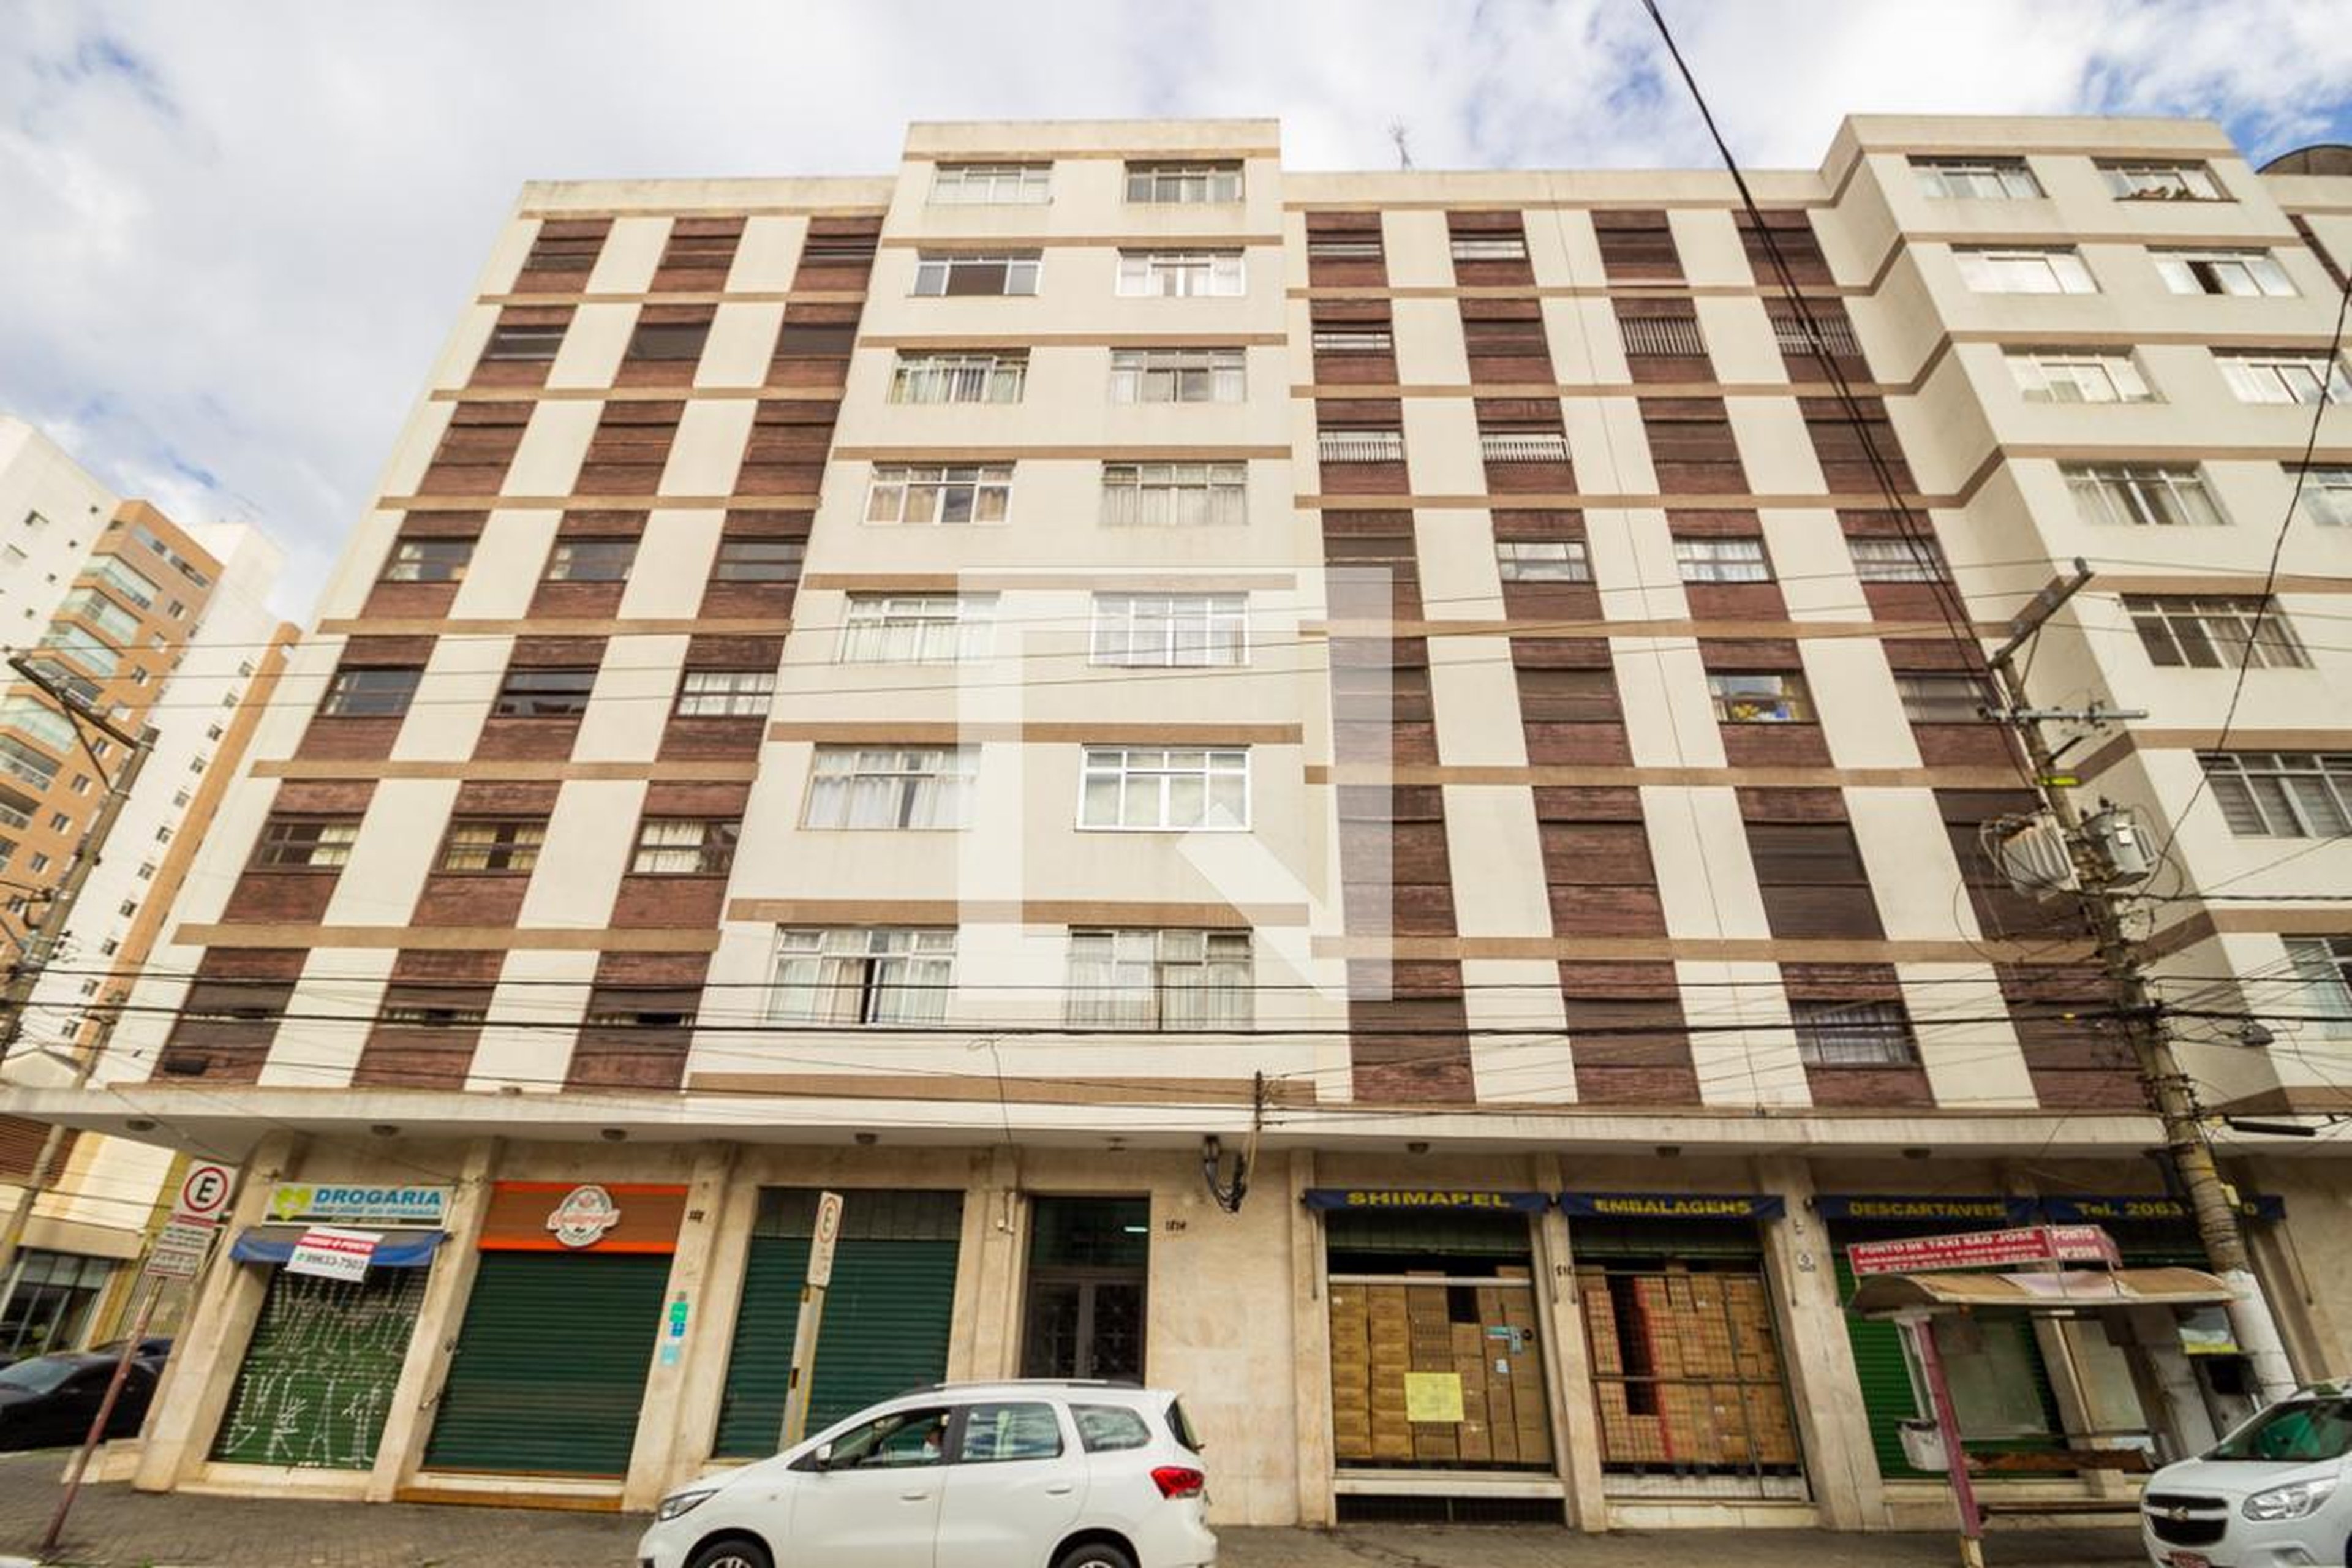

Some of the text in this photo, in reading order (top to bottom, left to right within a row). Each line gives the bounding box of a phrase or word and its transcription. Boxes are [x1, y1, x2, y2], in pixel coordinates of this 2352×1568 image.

[195, 1176, 217, 1203] E
[315, 1188, 442, 1205] DROGARIA
[1348, 1192, 1511, 1208] SHIMAPEL
[1594, 1199, 1752, 1215] EMBALAGENS
[2053, 1229, 2095, 1241] PONTO
[1858, 1243, 1905, 1254] PONTO
[1907, 1241, 1926, 1251] DE
[1929, 1237, 1961, 1249] TAXI
